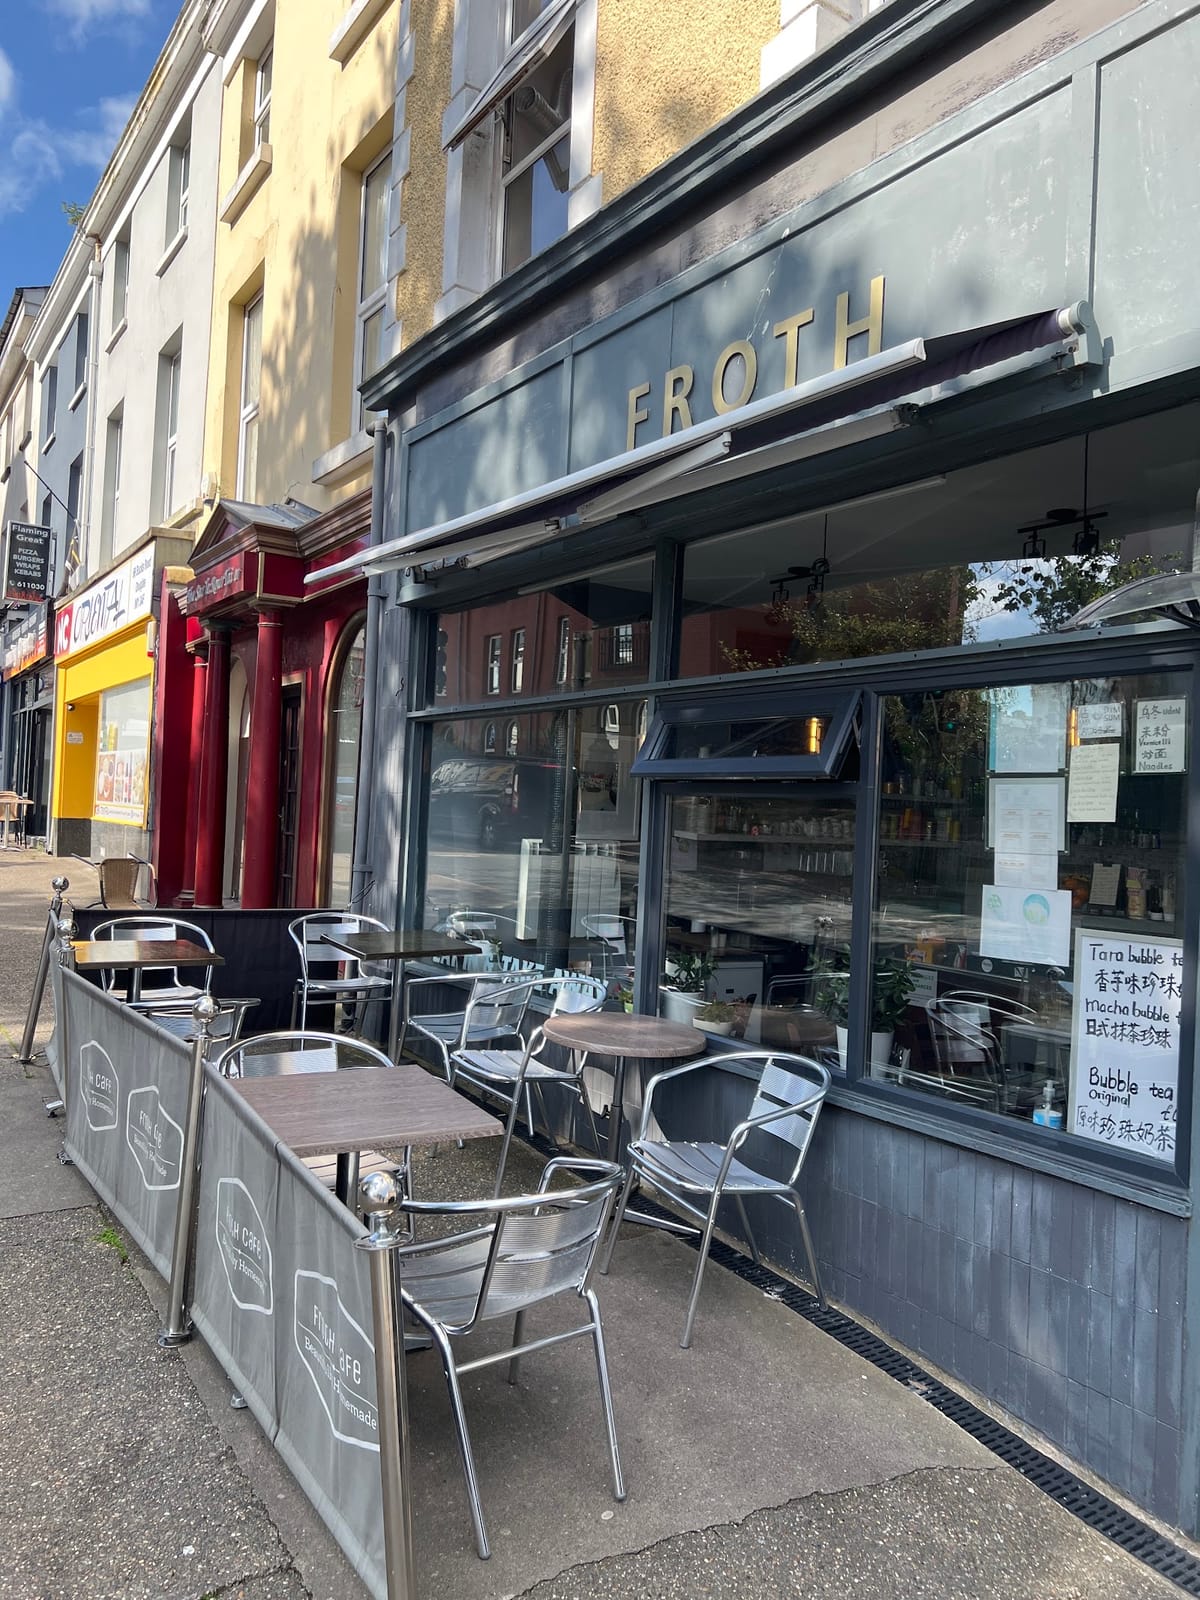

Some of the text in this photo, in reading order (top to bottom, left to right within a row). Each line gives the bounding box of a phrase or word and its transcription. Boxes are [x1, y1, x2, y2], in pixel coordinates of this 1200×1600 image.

[627, 275, 885, 450] FROTH
[12, 524, 48, 537] Flaming
[16, 534, 44, 544] Great
[18, 548, 38, 556] PIZZA
[13, 554, 45, 564] BURGERS
[16, 561, 41, 570] WRAPS
[14, 568, 42, 577] KEBABS
[17, 581, 45, 591] 611030
[1089, 943, 1124, 962] Taro
[1128, 944, 1165, 965] bubble
[1132, 1001, 1170, 1023] bubble
[1089, 1066, 1174, 1101] Bubble tea
[1089, 1089, 1131, 1108] Original
